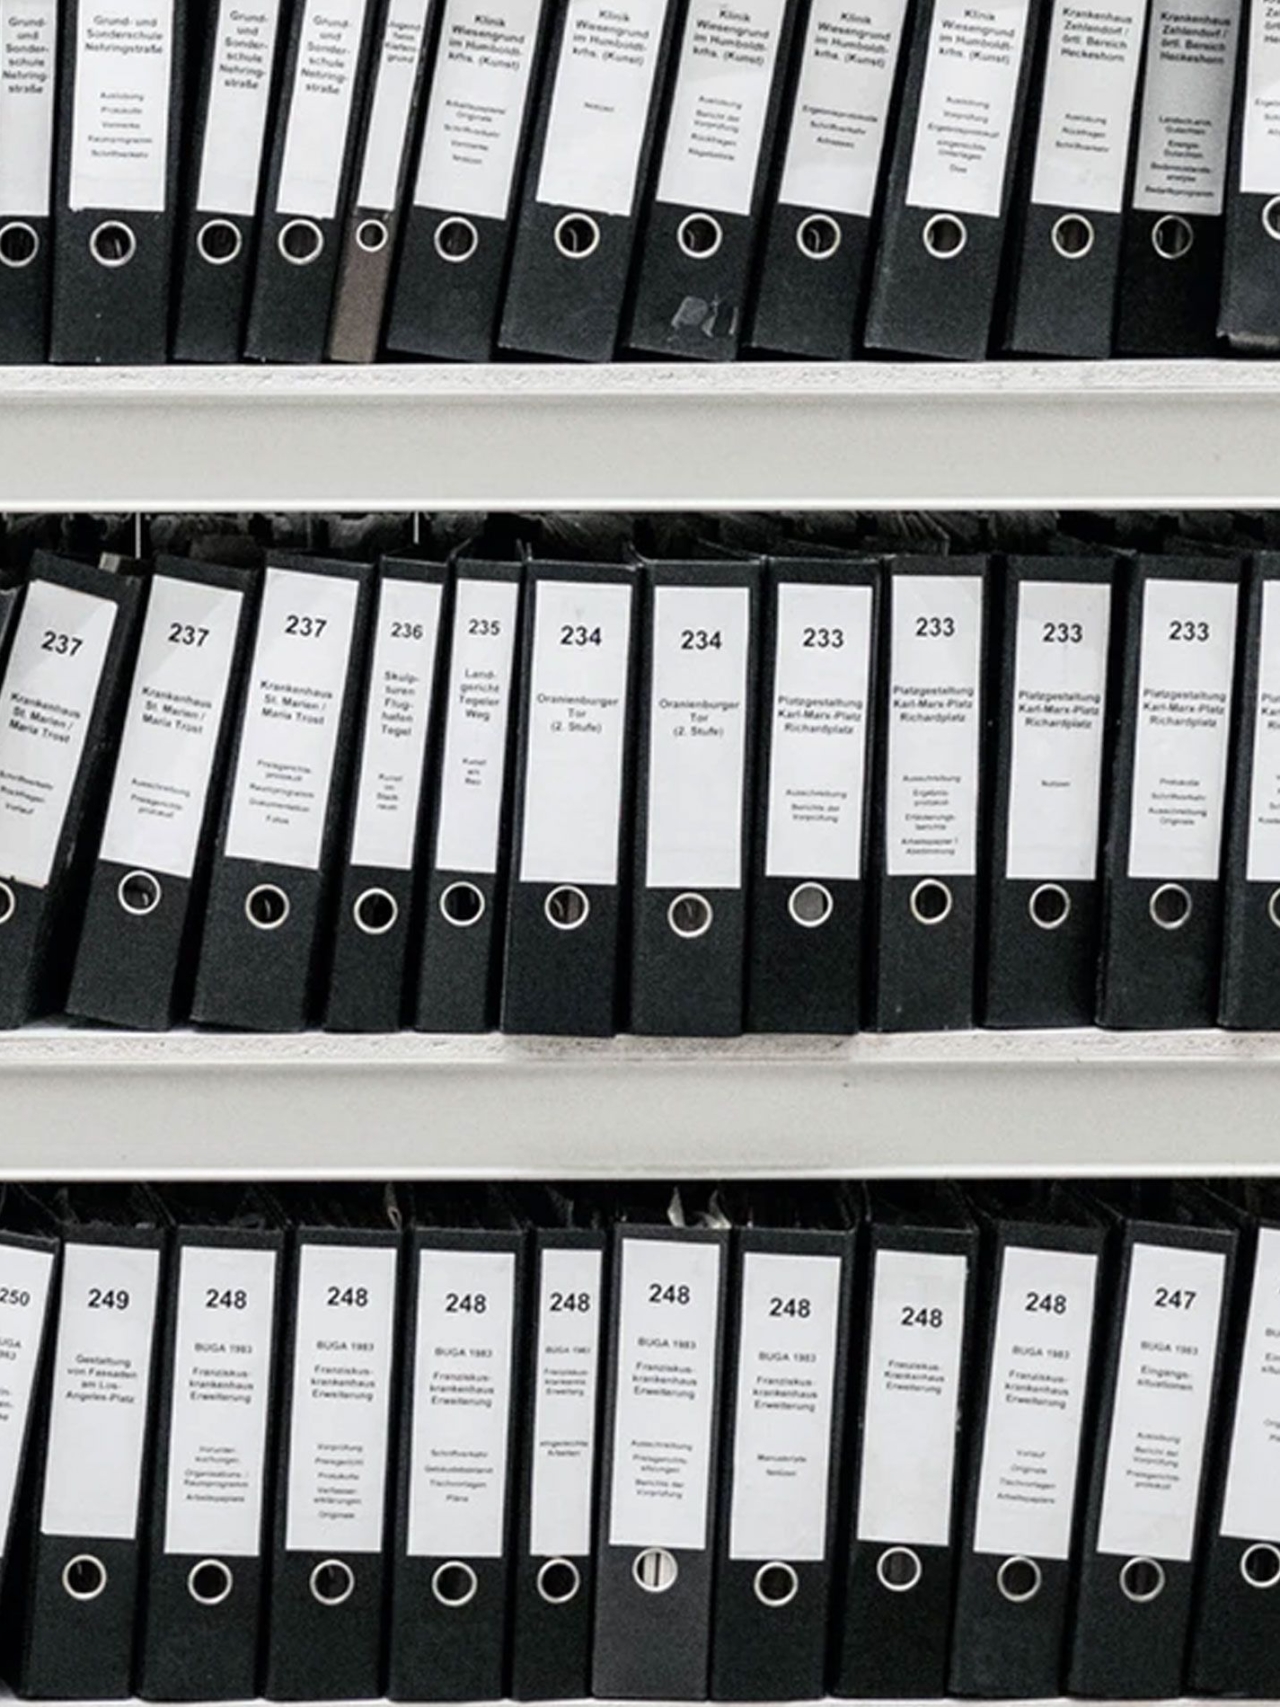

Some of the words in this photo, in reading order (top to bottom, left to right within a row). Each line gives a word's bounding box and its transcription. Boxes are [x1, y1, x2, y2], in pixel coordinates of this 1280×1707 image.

[135, 18, 158, 28] und
[474, 14, 506, 28] Klinik
[718, 9, 751, 23] Klinik
[1062, 7, 1133, 25] Krankenhaus
[1160, 11, 1233, 27] Krankenhaus
[16, 31, 39, 41] und
[451, 24, 525, 45] Wiesengrund
[696, 19, 770, 40] Wiesengrund
[1086, 35, 1128, 49] Bereich
[7, 57, 45, 68] schule
[167, 622, 210, 648] 237
[284, 614, 328, 639] 237
[390, 621, 424, 641] 236
[468, 618, 501, 636] 235
[560, 624, 603, 647] 234
[915, 616, 956, 638] 233
[1042, 622, 1083, 644] 233
[1168, 619, 1210, 643] 233
[40, 629, 84, 657] 237
[680, 629, 723, 651] 234
[802, 627, 845, 650] 233
[259, 680, 333, 700] Krankenhaus
[465, 709, 491, 722] Weg
[568, 707, 586, 718] Tor
[381, 723, 412, 738] Tegel
[87, 1287, 130, 1311] 249
[205, 1288, 248, 1310] 248
[326, 1285, 369, 1308] 248
[445, 1292, 487, 1315] 248
[548, 1291, 591, 1314] 248
[648, 1283, 691, 1306] 248
[1024, 1291, 1067, 1316] 248
[1154, 1286, 1197, 1311] 247
[768, 1296, 812, 1319] 248
[900, 1305, 944, 1329] 248
